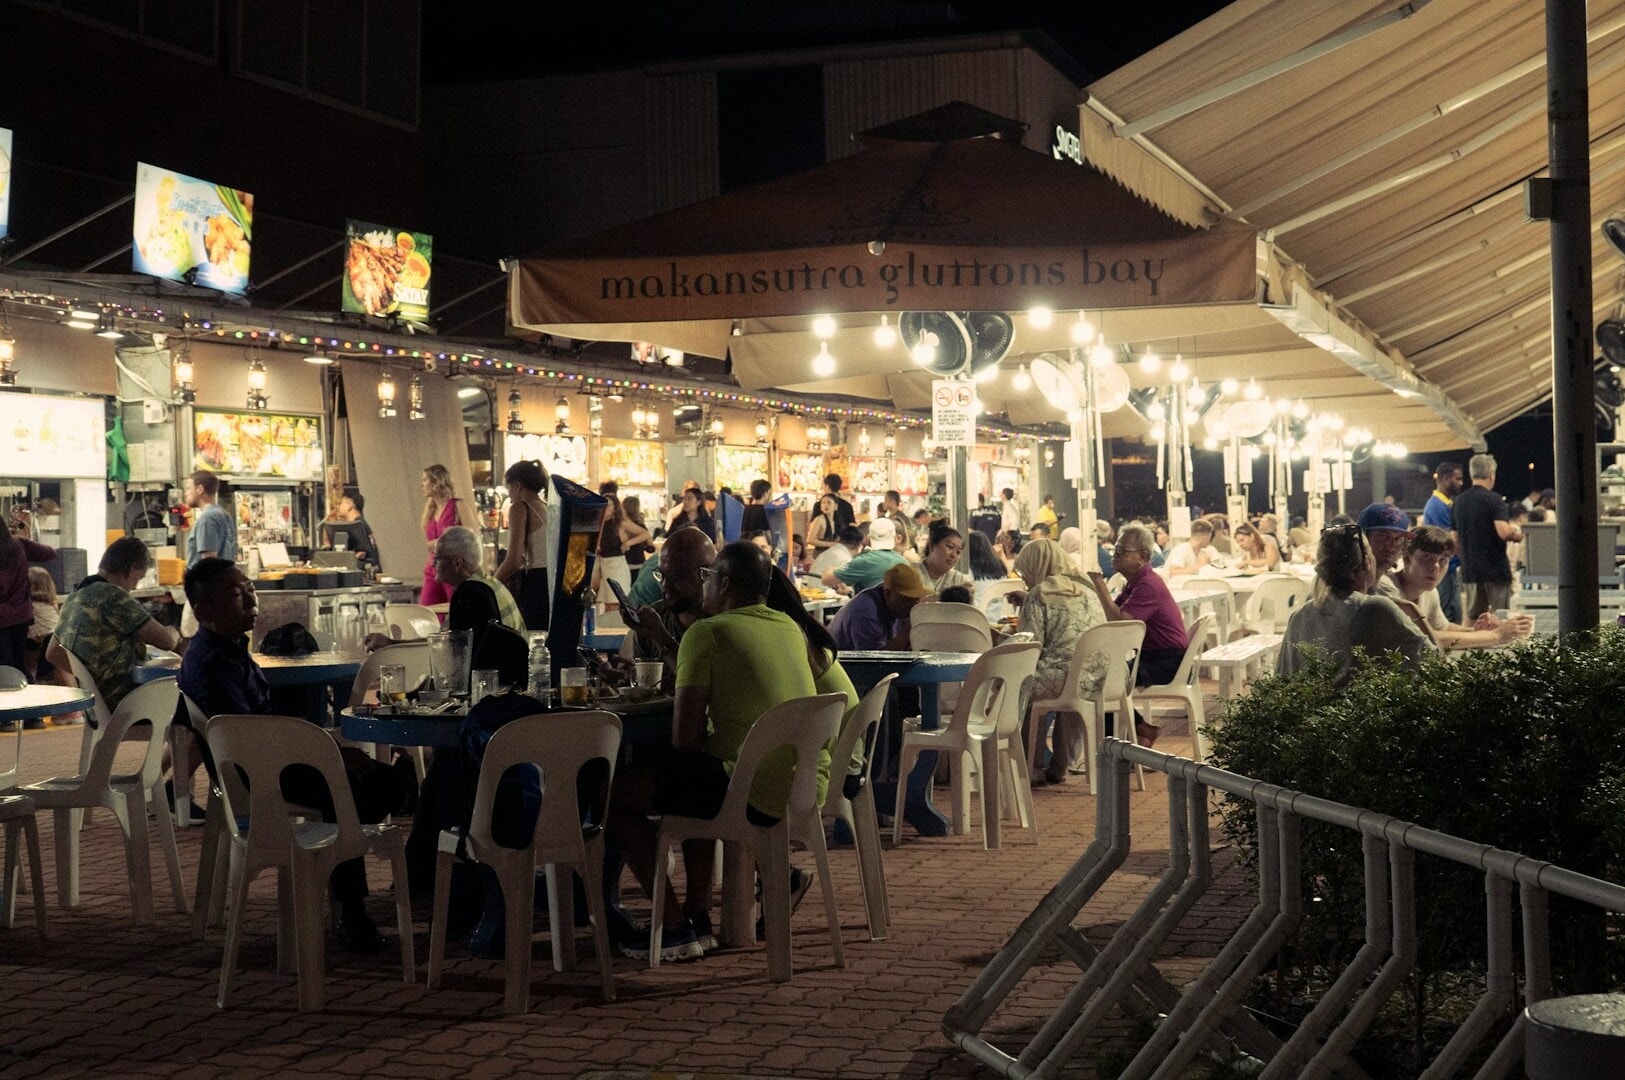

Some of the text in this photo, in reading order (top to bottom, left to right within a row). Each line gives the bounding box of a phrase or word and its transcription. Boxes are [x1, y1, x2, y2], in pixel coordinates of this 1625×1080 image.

[601, 249, 1167, 305] makansutra gluttons bay
